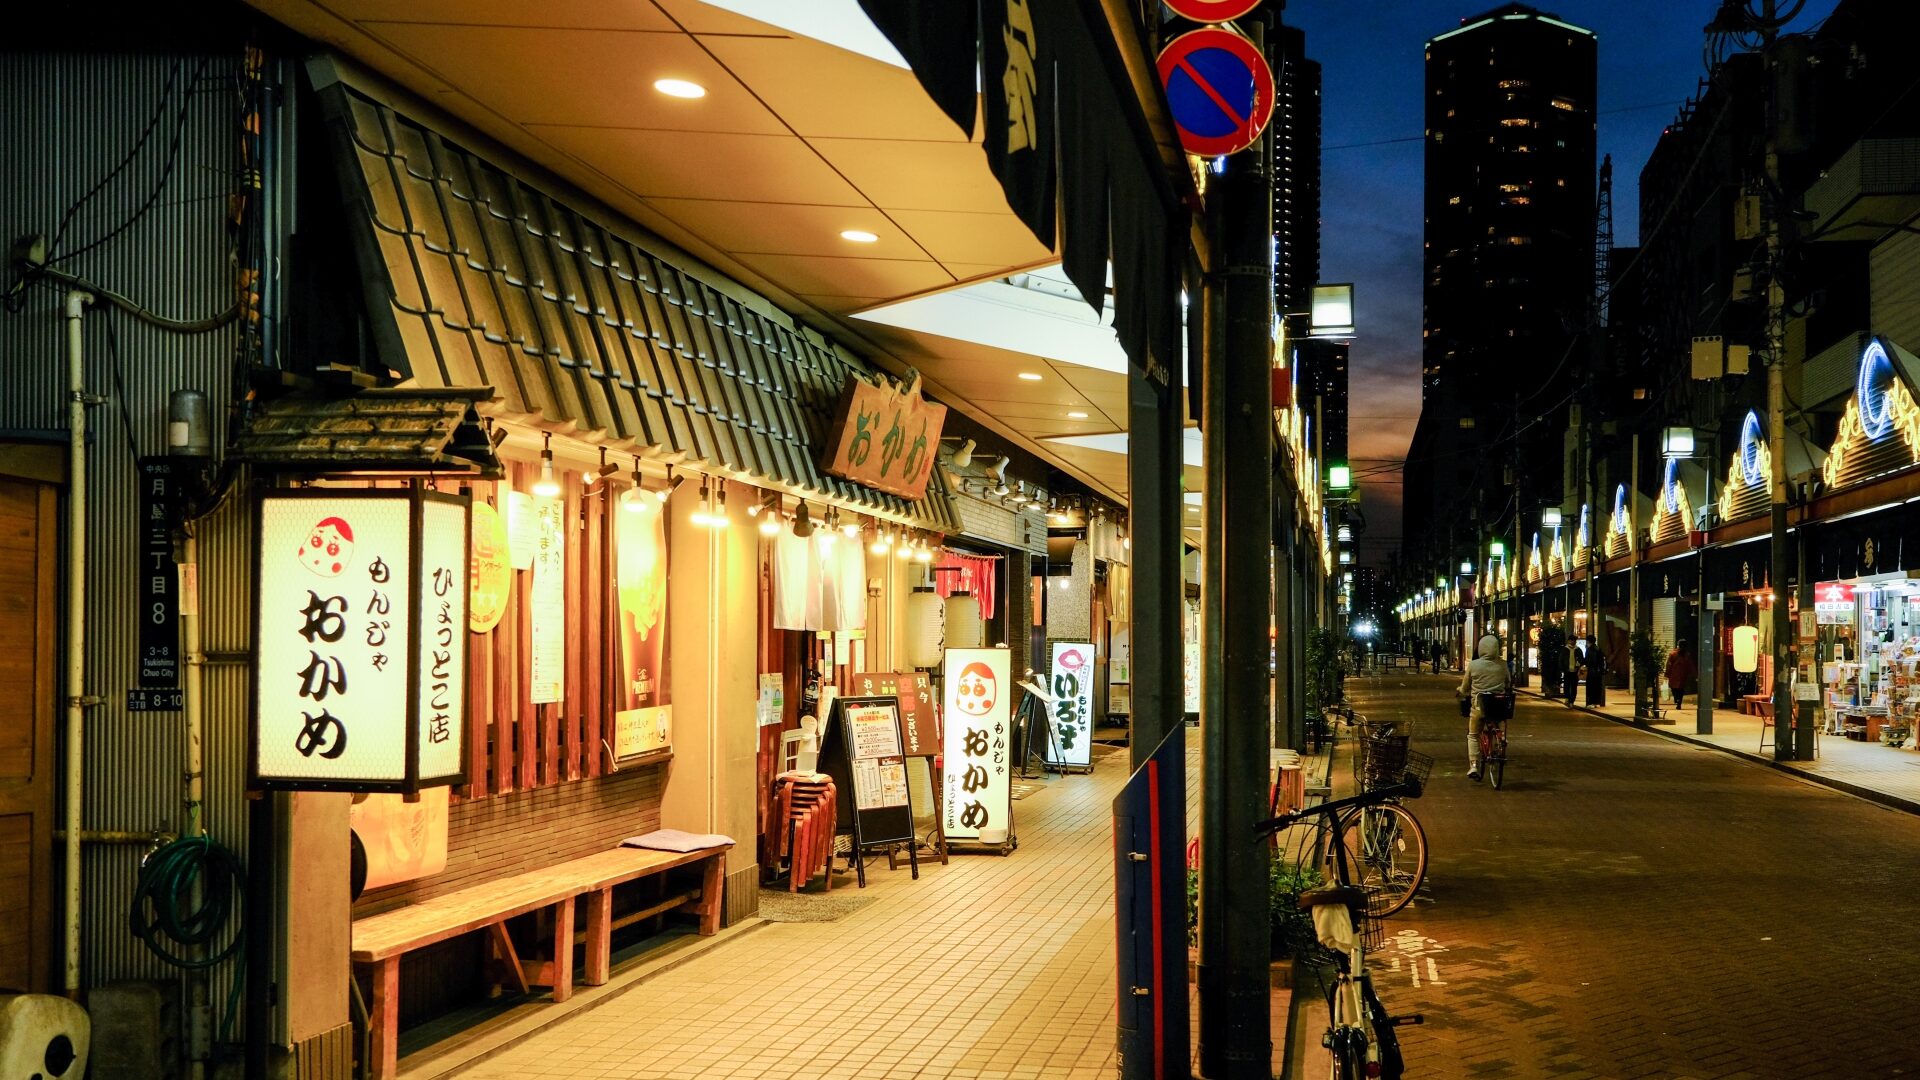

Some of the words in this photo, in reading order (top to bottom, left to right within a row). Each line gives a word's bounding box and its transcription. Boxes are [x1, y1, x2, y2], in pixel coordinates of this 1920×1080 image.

[366, 555, 391, 673] もんじゃ
[1824, 584, 1844, 602] 本
[143, 658, 175, 667] Tsukishima
[143, 668, 160, 677] Chuo
[161, 668, 174, 678] City
[149, 646, 169, 656] 3-8
[428, 566, 457, 745] ひょっとこ店
[295, 589, 349, 761] おかめ
[153, 694, 183, 706] 8-10
[1055, 672, 1079, 750] いろは
[1078, 695, 1087, 733] もんじゃ
[993, 721, 1005, 776] もんじゃ
[960, 726, 989, 830] おかめ
